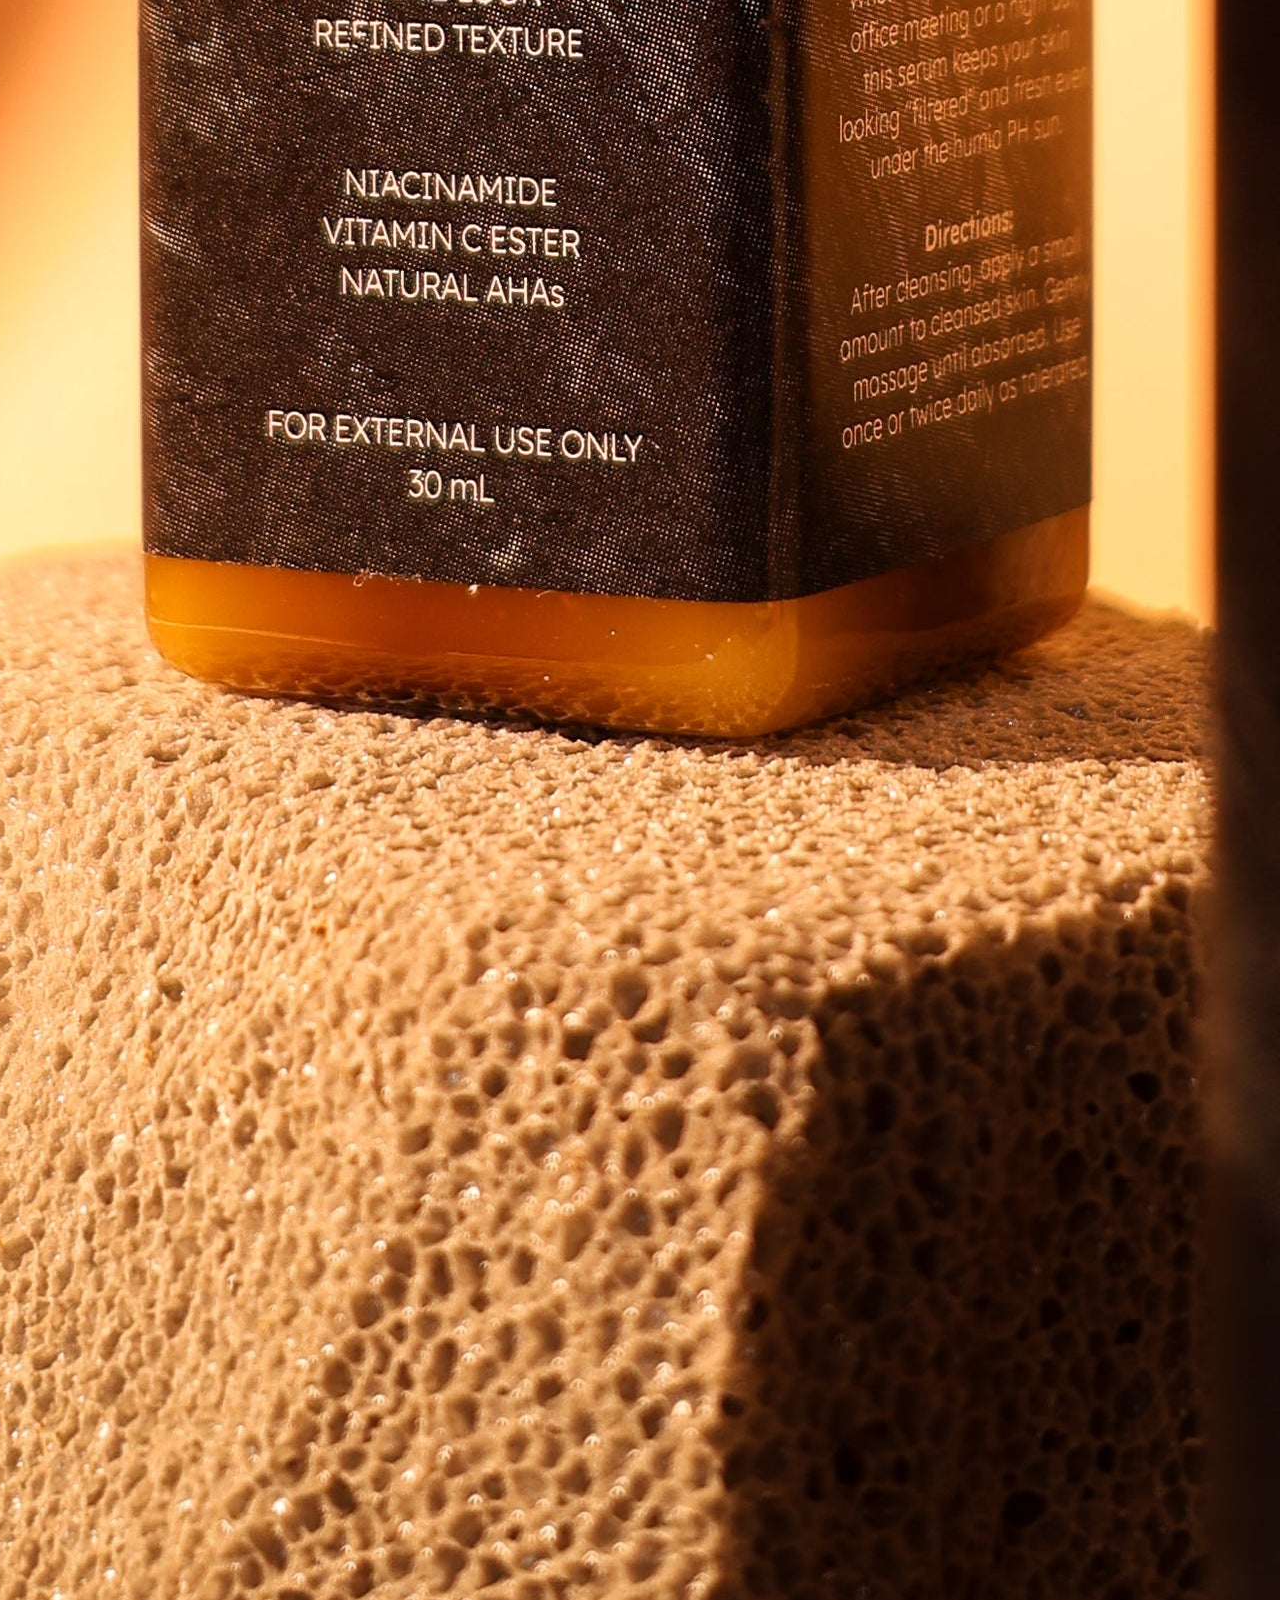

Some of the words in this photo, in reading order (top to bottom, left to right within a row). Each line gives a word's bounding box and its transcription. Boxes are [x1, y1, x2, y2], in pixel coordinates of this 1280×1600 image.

[315, 20, 446, 52] REFINED
[454, 24, 583, 57] TEXTURE
[851, 20, 899, 54] office
[903, 6, 970, 42] meeting
[975, 4, 991, 27] or
[996, 2, 1006, 22] a
[864, 65, 893, 94] this
[898, 56, 948, 89] serum
[953, 45, 998, 75] keeps
[1002, 38, 1035, 72] your
[838, 106, 901, 143] looking
[979, 82, 1010, 109] and
[871, 147, 919, 179] under
[923, 142, 949, 166] the
[1008, 119, 1028, 143] PH
[344, 169, 557, 207] NIACINAMIDE
[322, 217, 451, 251] VITAMIN
[461, 225, 482, 252] C
[492, 226, 580, 257] ESTER
[924, 210, 1013, 253] Directions:
[340, 268, 478, 302] NATURAL
[488, 278, 565, 307] AHAs
[851, 282, 892, 316] After
[980, 250, 1024, 283] apply
[1029, 246, 1039, 267] a
[840, 323, 904, 364] amount
[910, 316, 926, 342] to
[931, 297, 1002, 338] cleansed
[853, 360, 929, 402] massage
[932, 340, 967, 379] until
[971, 327, 1049, 368] absorbed.
[1054, 314, 1082, 343] Use
[266, 410, 326, 442] FOR
[336, 415, 485, 454] EXTERNAL
[495, 427, 551, 457] USE
[561, 432, 643, 462] ONLY
[842, 420, 883, 450] once
[888, 409, 905, 435] or
[909, 390, 953, 427] twice
[956, 379, 995, 416] daily
[999, 375, 1017, 402] as
[408, 469, 441, 499] 30
[450, 475, 494, 503] mL
